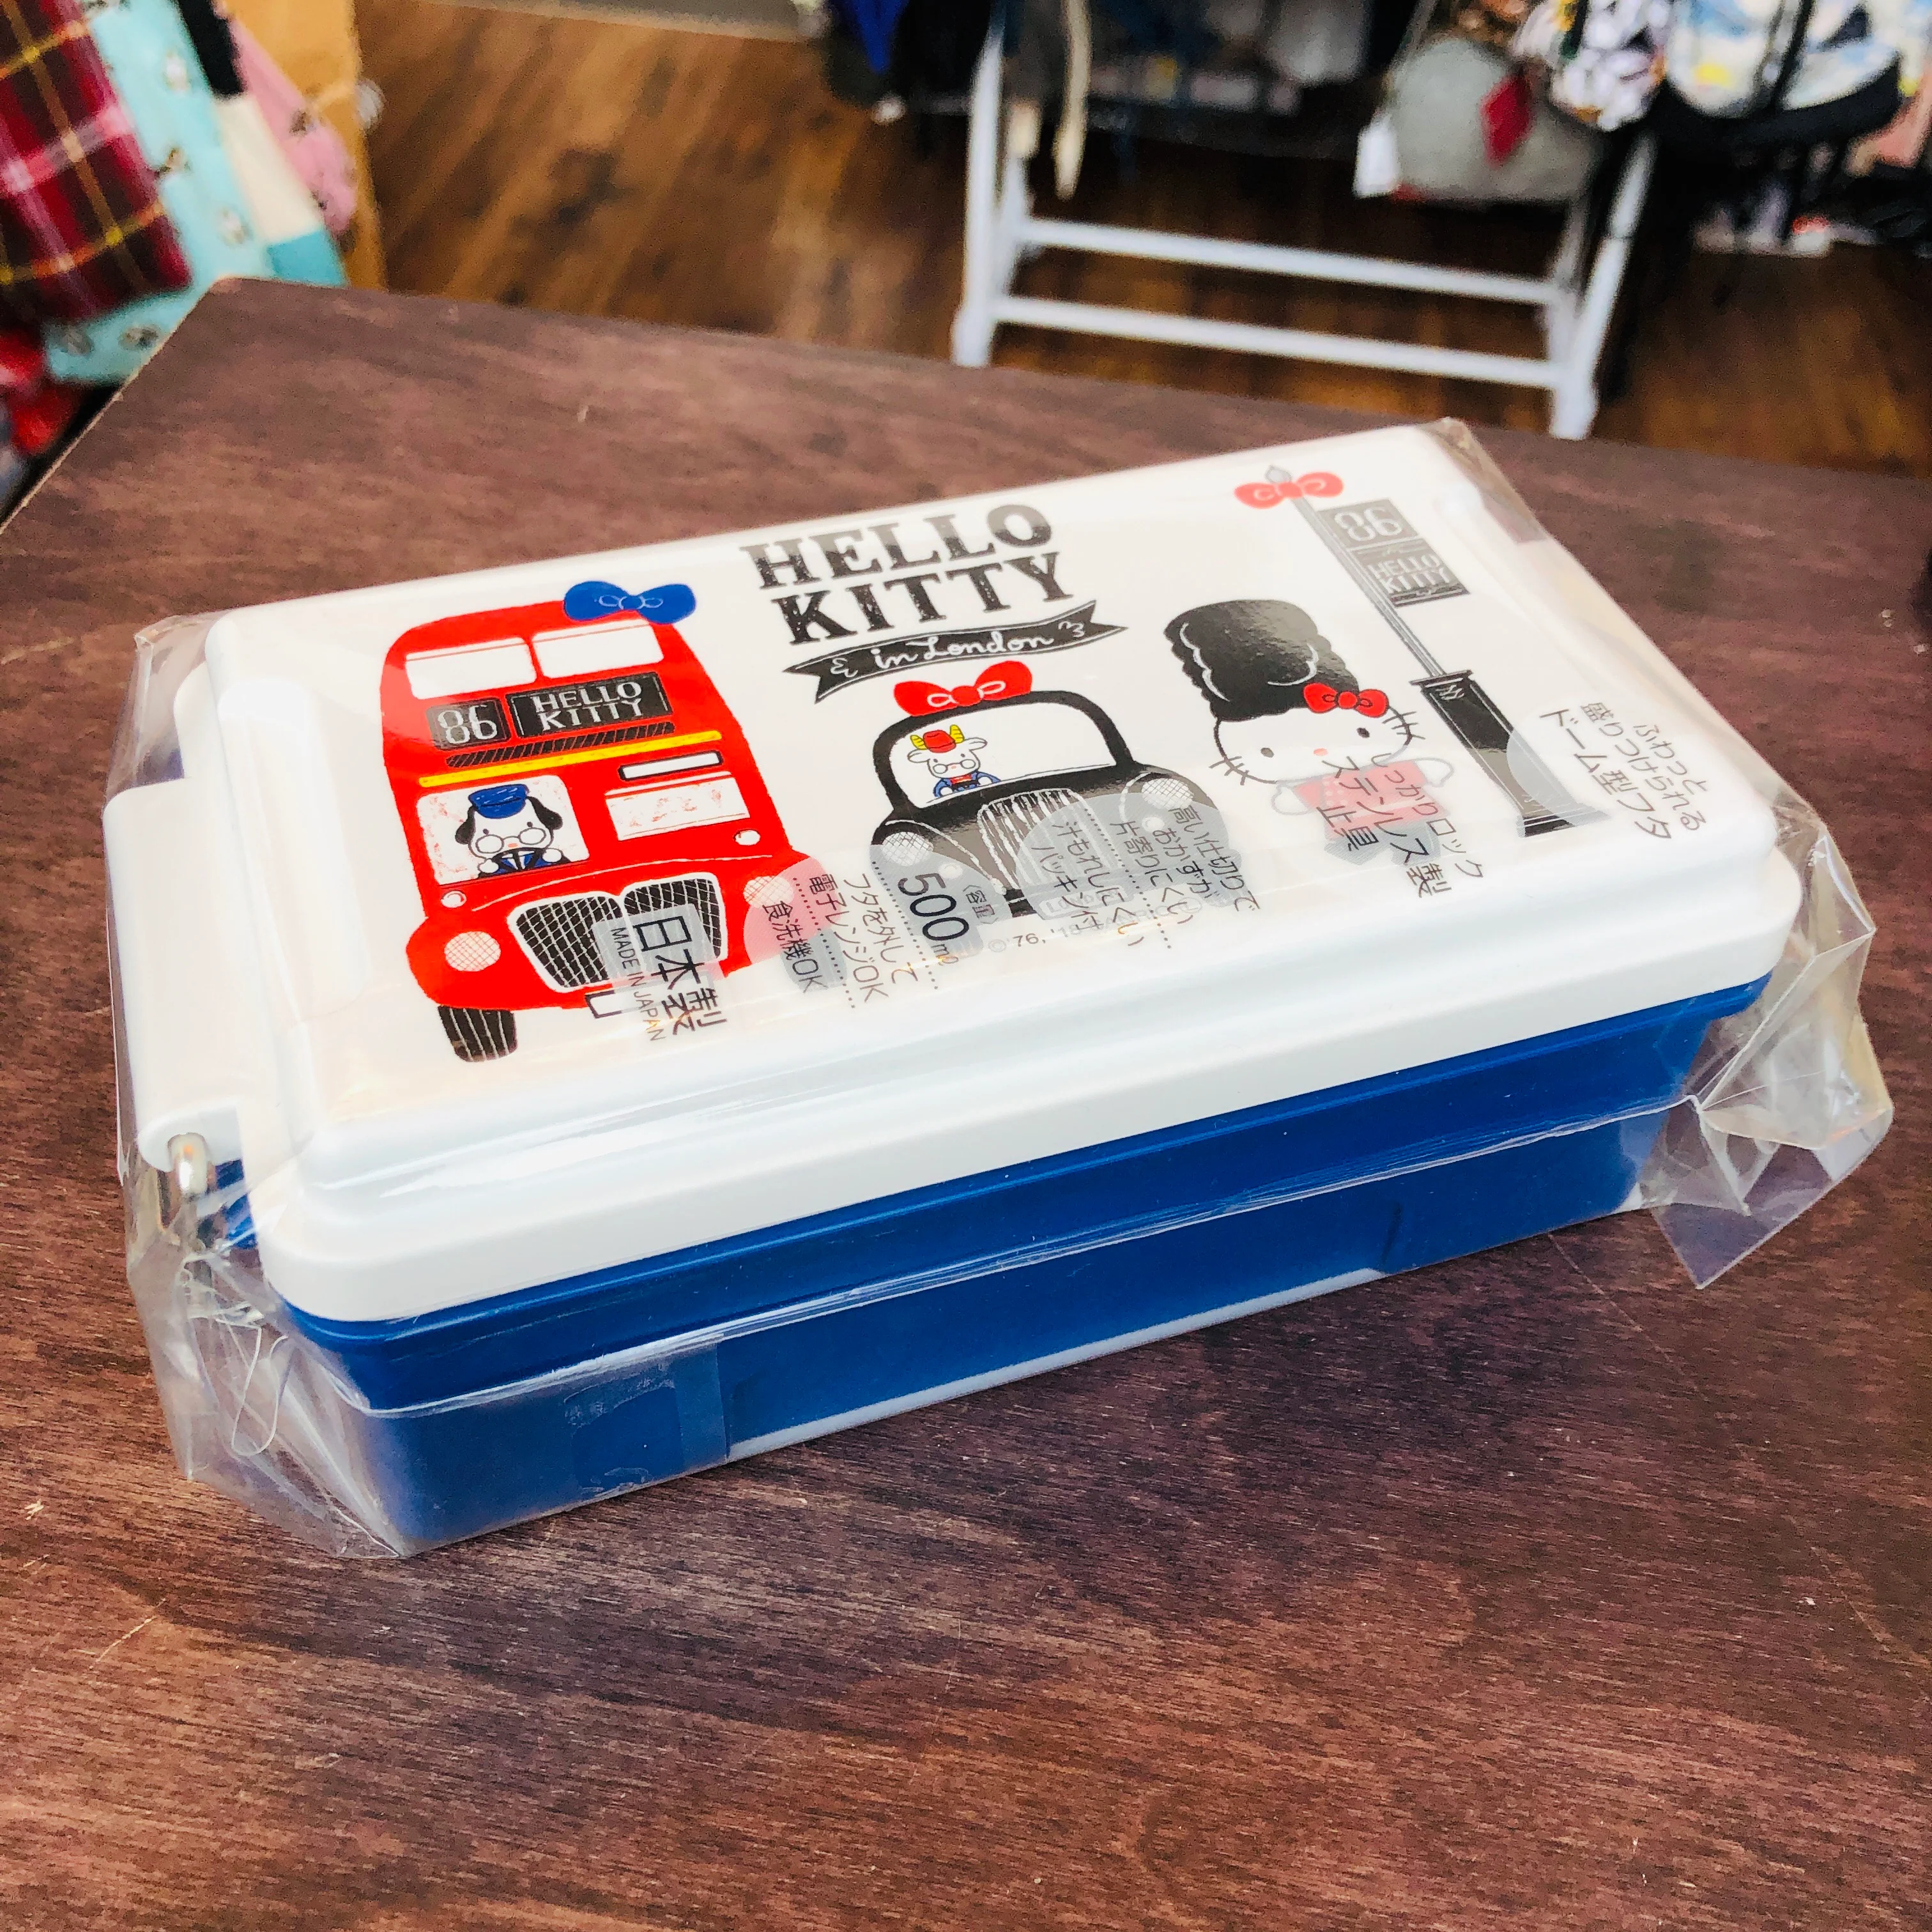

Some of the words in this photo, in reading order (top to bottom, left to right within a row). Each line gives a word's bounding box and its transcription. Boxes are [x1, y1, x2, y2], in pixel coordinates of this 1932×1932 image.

[739, 504, 1054, 589] HELLO
[1334, 507, 1403, 542] 86
[771, 552, 1073, 645] KITTY
[1367, 553, 1441, 579] HELLO
[1379, 567, 1450, 594] KITTY
[870, 648, 917, 670] in
[905, 631, 1054, 660] London
[437, 705, 498, 744] 86
[530, 682, 642, 712] HELLO
[537, 698, 643, 731] KITTY
[1539, 709, 1671, 839] ドーム型フタ
[1580, 702, 1706, 831] 盛りつけられる
[1633, 724, 1709, 795] ふわっと
[1322, 756, 1452, 898] ステンレス製
[1371, 753, 1483, 878] しっかりロック
[1152, 827, 1220, 898] おかずが
[1168, 804, 1261, 912] 高い仕切りで
[611, 927, 640, 969] MADE
[762, 900, 829, 993] 食洗機OK
[809, 873, 889, 1002] 電子レンジOK
[843, 873, 918, 984] フタを外して
[627, 971, 647, 987] IN
[632, 916, 728, 1035] 日本製
[633, 991, 667, 1041] JAPAN
